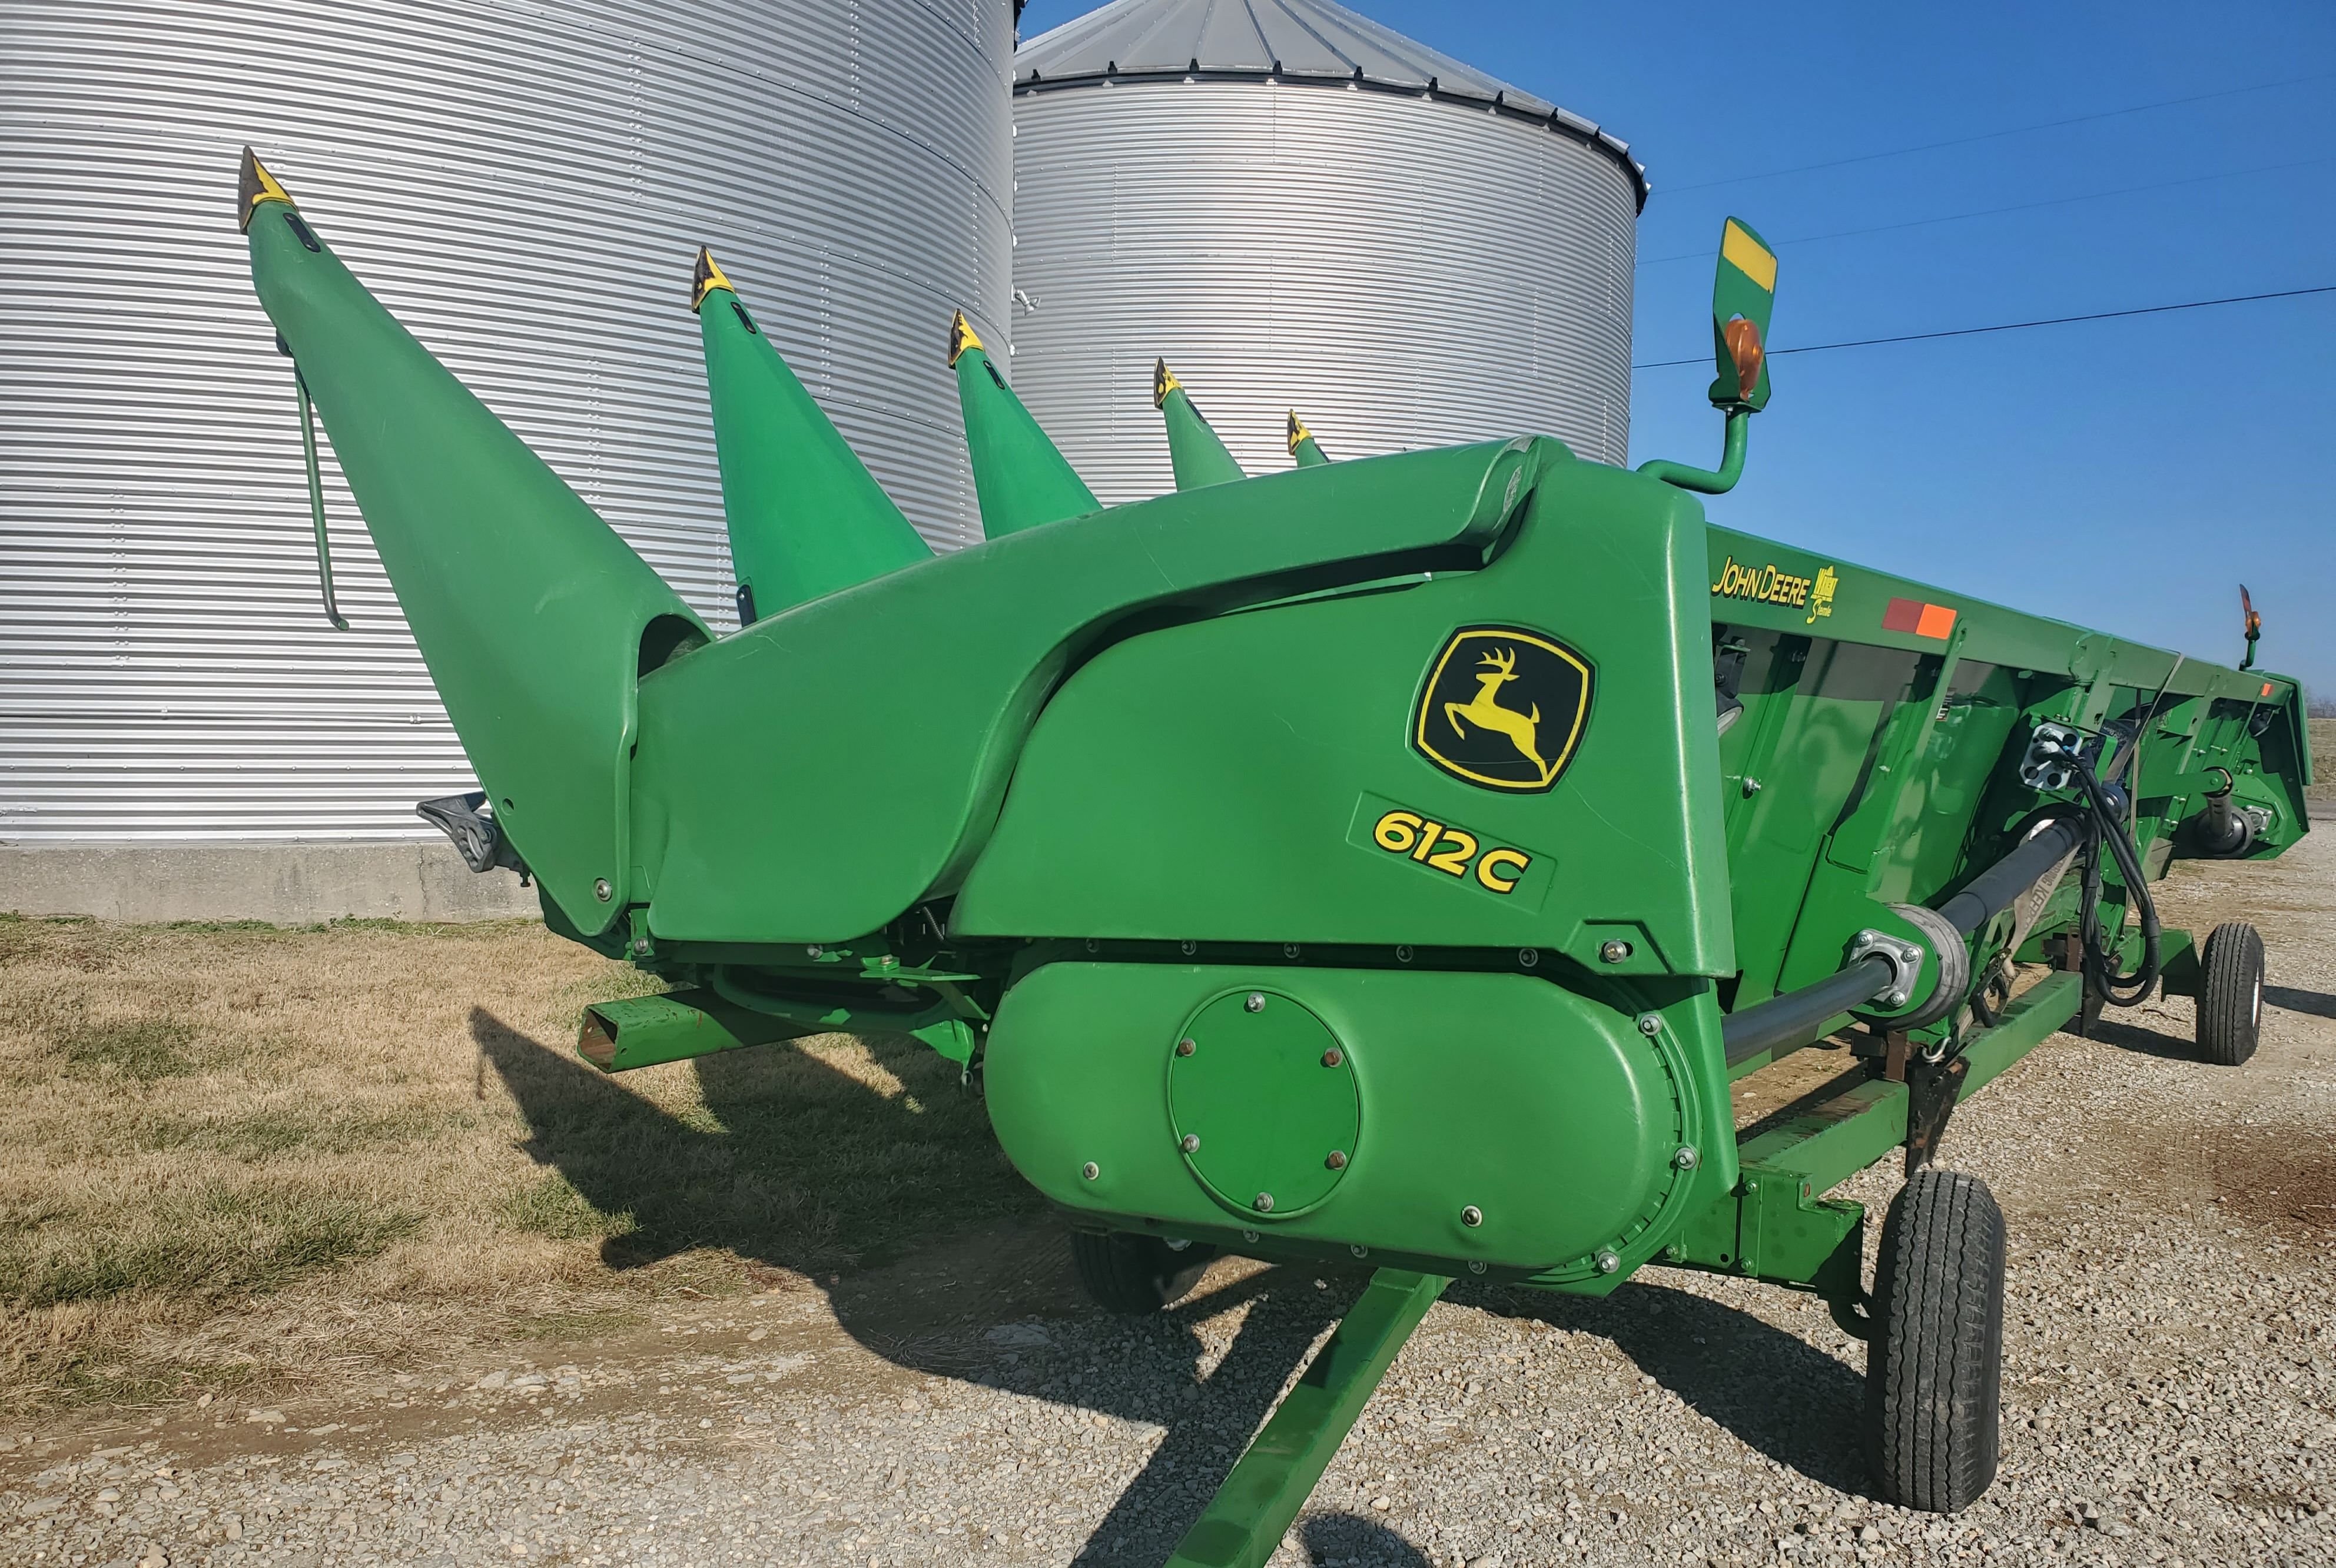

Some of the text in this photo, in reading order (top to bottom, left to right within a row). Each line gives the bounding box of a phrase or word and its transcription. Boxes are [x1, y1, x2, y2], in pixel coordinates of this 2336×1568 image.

[1711, 556, 1811, 609] JOHN DEERE
[1373, 810, 1533, 894] 612C
